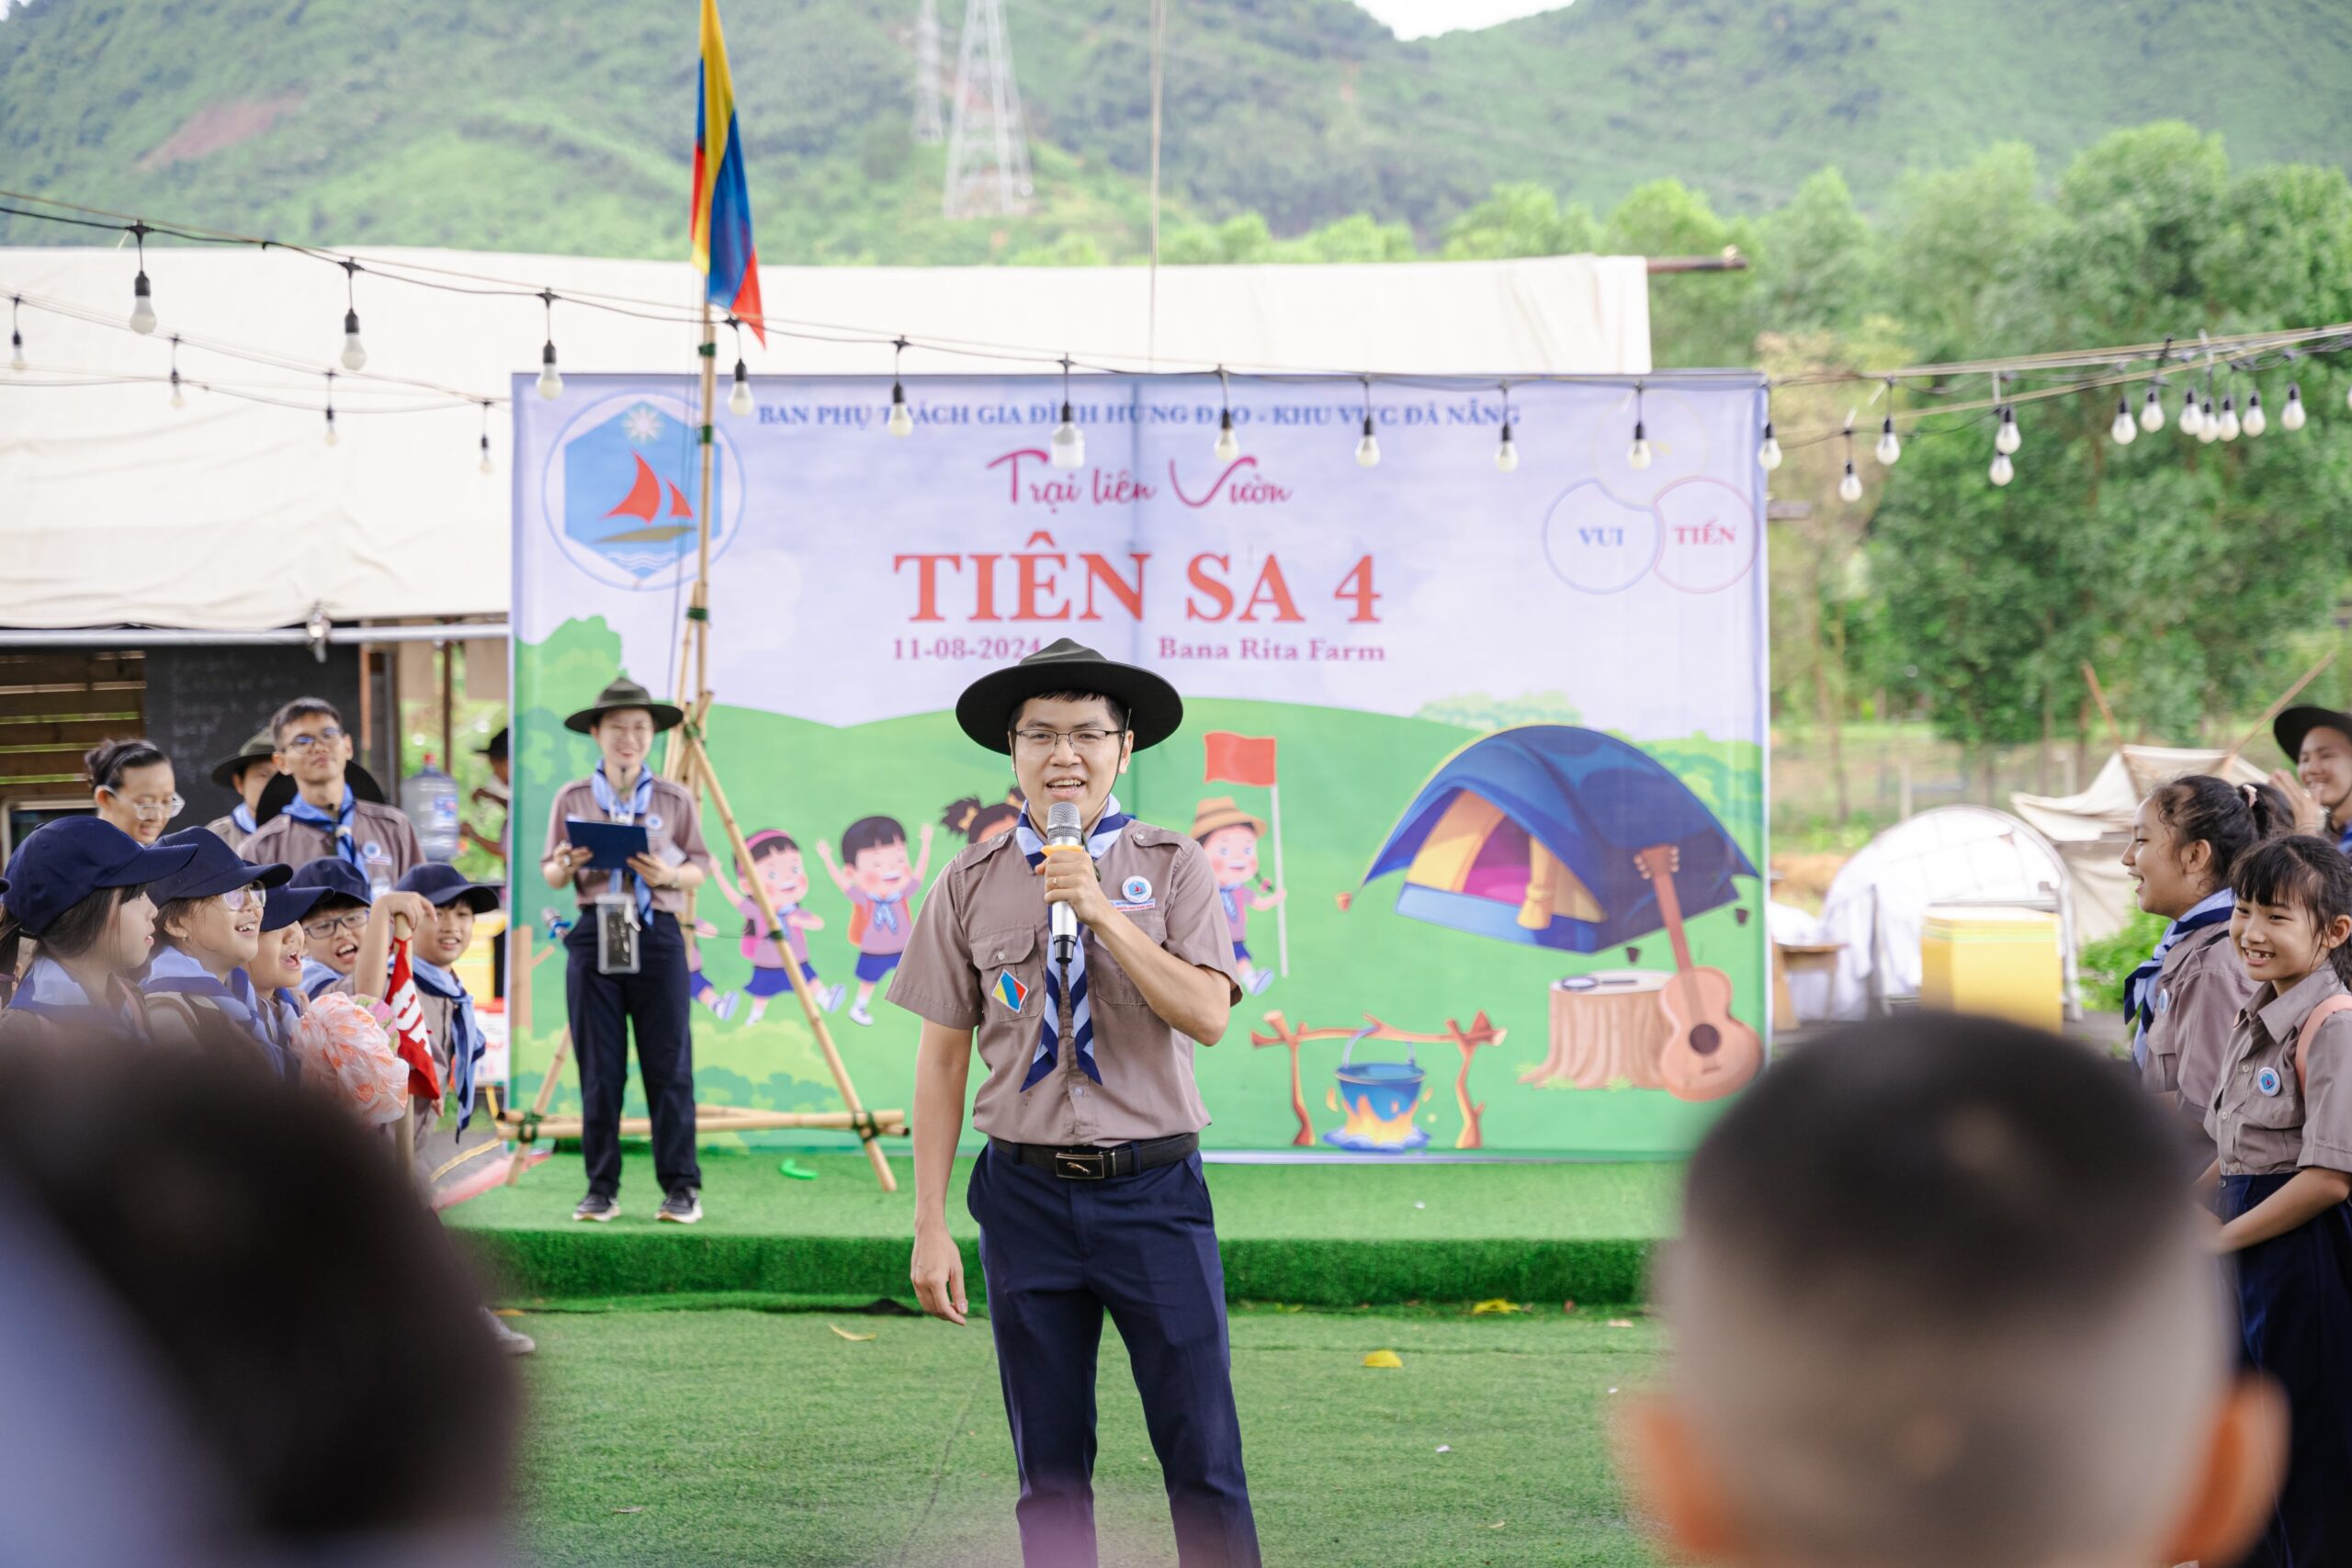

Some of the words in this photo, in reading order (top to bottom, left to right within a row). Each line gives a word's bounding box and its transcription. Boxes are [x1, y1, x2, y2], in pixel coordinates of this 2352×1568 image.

[758, 404, 809, 425] BAN
[817, 404, 872, 430] PHỤ
[881, 399, 969, 425] TÁCH
[977, 404, 1022, 425] GIA
[1029, 400, 1099, 425] ĐÌH
[1196, 404, 1250, 425] ĐO
[1272, 404, 1332, 425] KHU
[986, 449, 1081, 514] Trại
[1092, 468, 1157, 504] liên
[1578, 527, 1624, 546] VUI
[1674, 517, 1736, 546] TIẾN
[892, 530, 1151, 622] TIÊN
[1186, 551, 1306, 623] SA
[1333, 553, 1383, 623] 4
[1158, 637, 1229, 660] Bana
[1240, 637, 1299, 660] Rita
[1309, 638, 1385, 660] Farm
